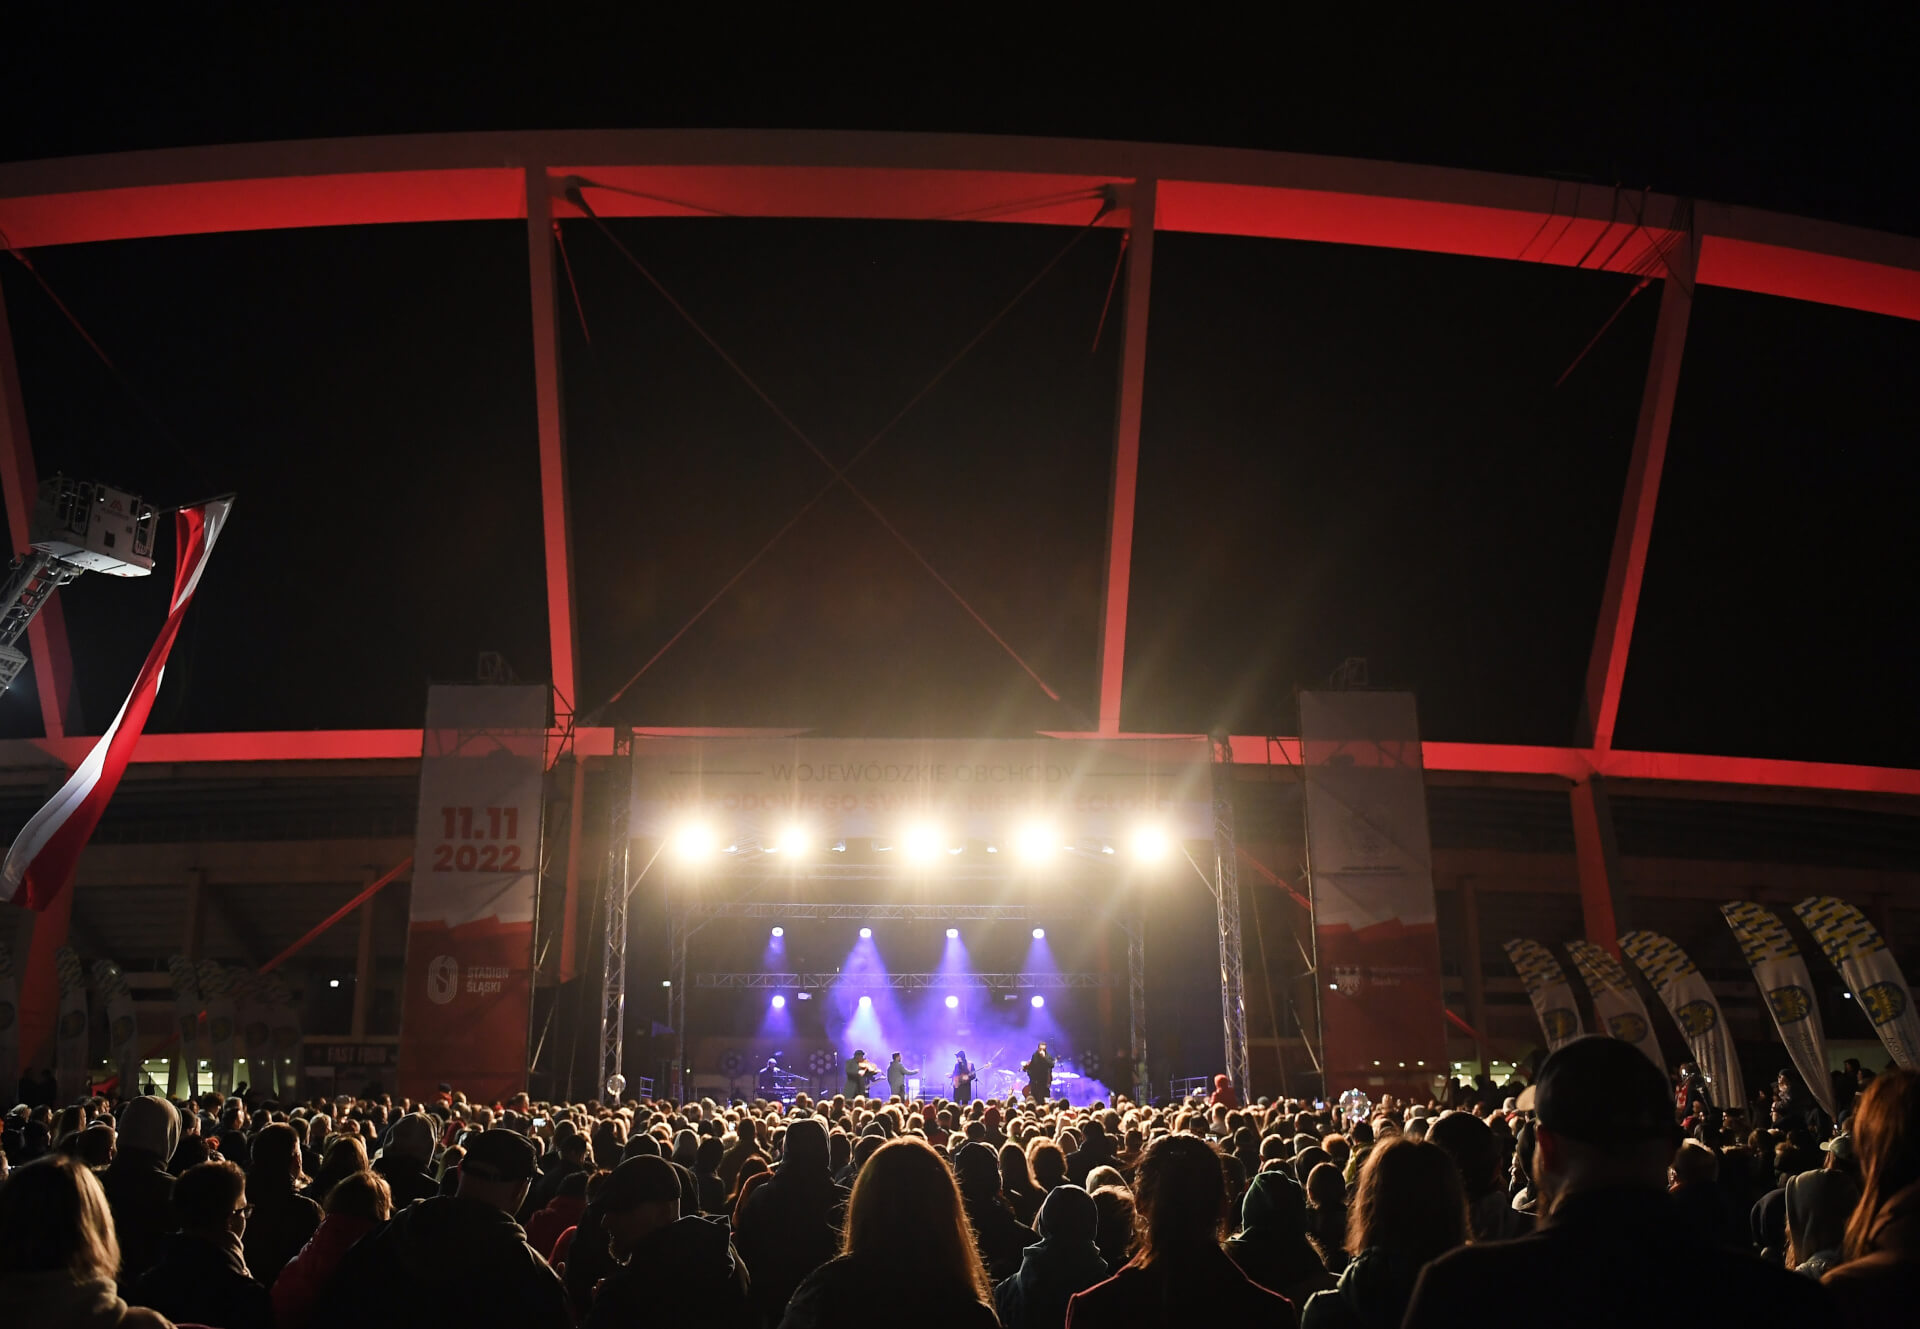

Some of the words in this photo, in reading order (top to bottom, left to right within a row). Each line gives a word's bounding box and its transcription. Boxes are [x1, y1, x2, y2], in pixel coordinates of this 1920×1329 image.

[771, 760, 946, 783] WOJEWÓDZKIE
[956, 764, 1077, 783] OBCHODY
[441, 807, 519, 840] 11.11
[432, 845, 521, 873] 2022
[467, 967, 510, 979] STADION
